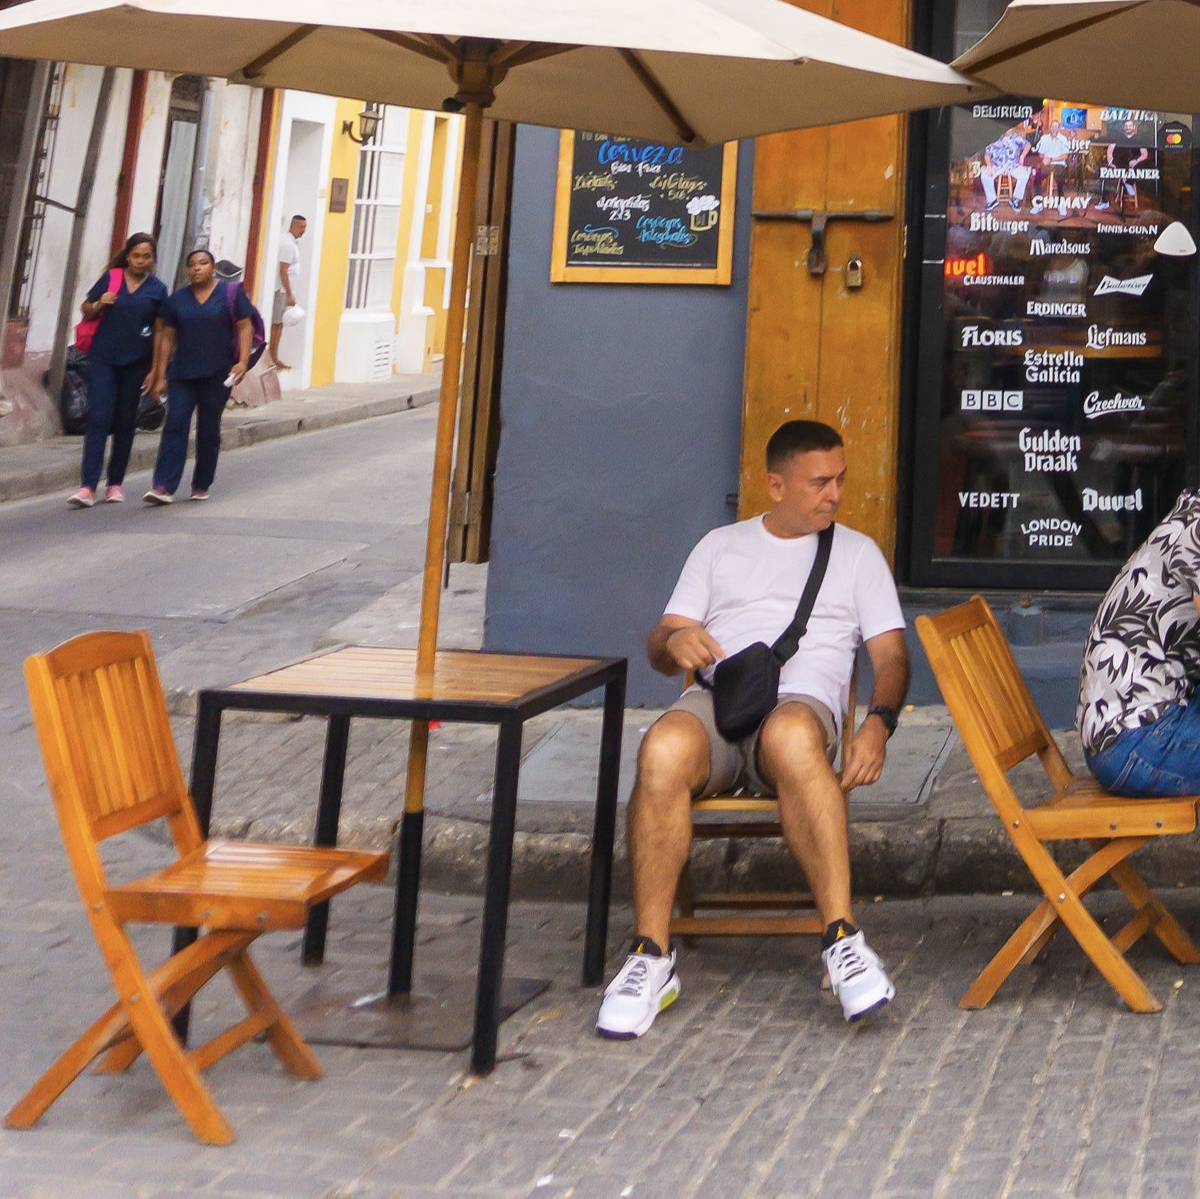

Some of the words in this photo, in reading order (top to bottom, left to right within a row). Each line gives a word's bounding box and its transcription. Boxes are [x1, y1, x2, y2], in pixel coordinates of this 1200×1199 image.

[973, 104, 1033, 119] DELIRIUM
[597, 140, 684, 165] Cerveza
[1100, 167, 1160, 180] PAULANER
[1031, 194, 1092, 209] CHIMAY
[969, 211, 1030, 234] Bitburger
[1030, 238, 1090, 256] Maredsous
[963, 275, 1025, 286] CLAUSTHALER
[1026, 301, 1087, 317] ERDINGER
[961, 325, 1023, 347] FLORIS
[1085, 324, 1147, 349] Liefmans
[1023, 349, 1084, 367] Estrella
[1025, 366, 1080, 383] Galicia
[964, 391, 1021, 408] BBC
[1083, 390, 1145, 417] Czechvar
[1018, 427, 1081, 451] Gulden
[1024, 451, 1078, 472] Draak
[958, 492, 1020, 508] VEDETT
[1082, 488, 1143, 511] Duvel
[1021, 518, 1082, 535] LONDON
[1029, 534, 1073, 546] PRIDE
